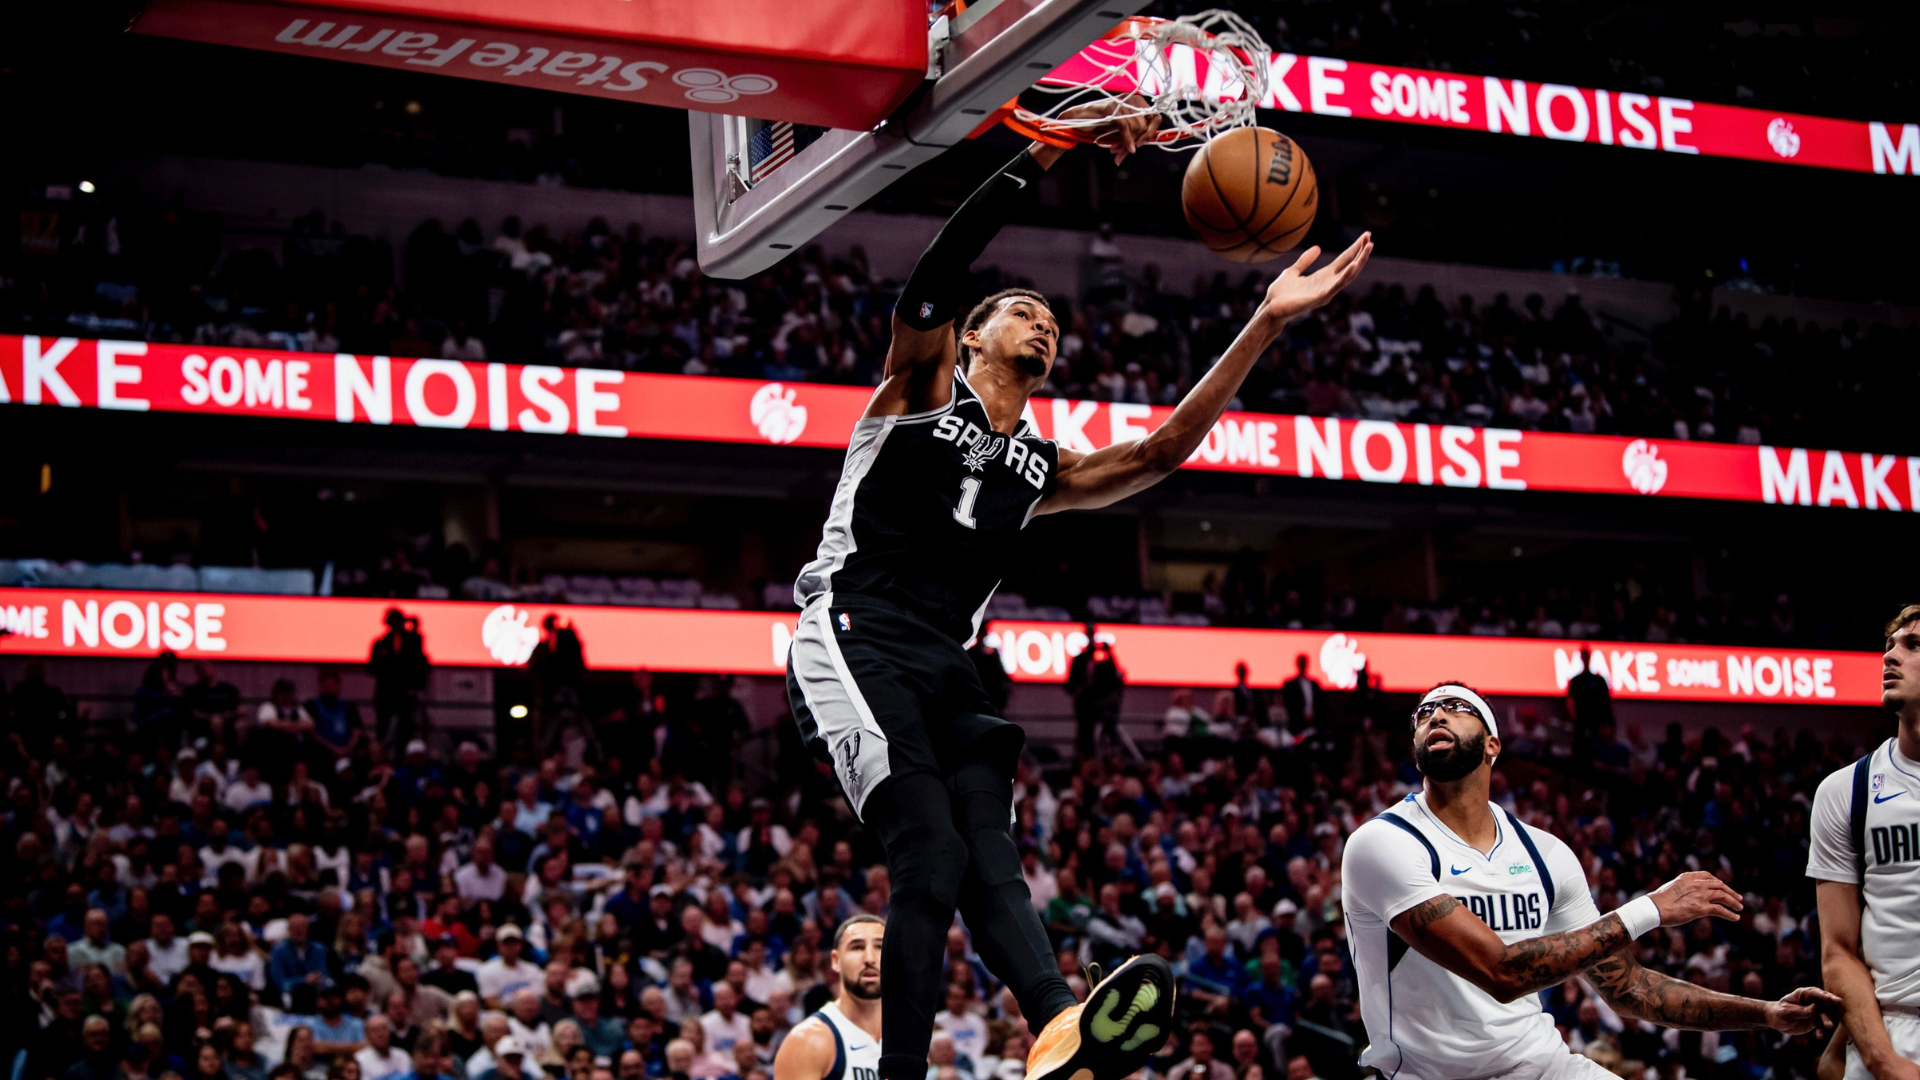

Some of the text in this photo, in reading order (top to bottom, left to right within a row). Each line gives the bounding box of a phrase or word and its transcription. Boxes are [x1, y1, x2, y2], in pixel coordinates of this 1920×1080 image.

[1370, 71, 1470, 124] SOME
[1483, 76, 1700, 155] NOISE
[0, 334, 629, 438] KE SOME NOISE
[1186, 418, 1281, 467] OME
[1294, 415, 1528, 491] NOISE
[953, 475, 983, 530] 1
[62, 599, 228, 652] NOISE
[1666, 658, 1722, 688] SOME
[1726, 654, 1836, 698] NOISE
[1508, 863, 1532, 876] chime
